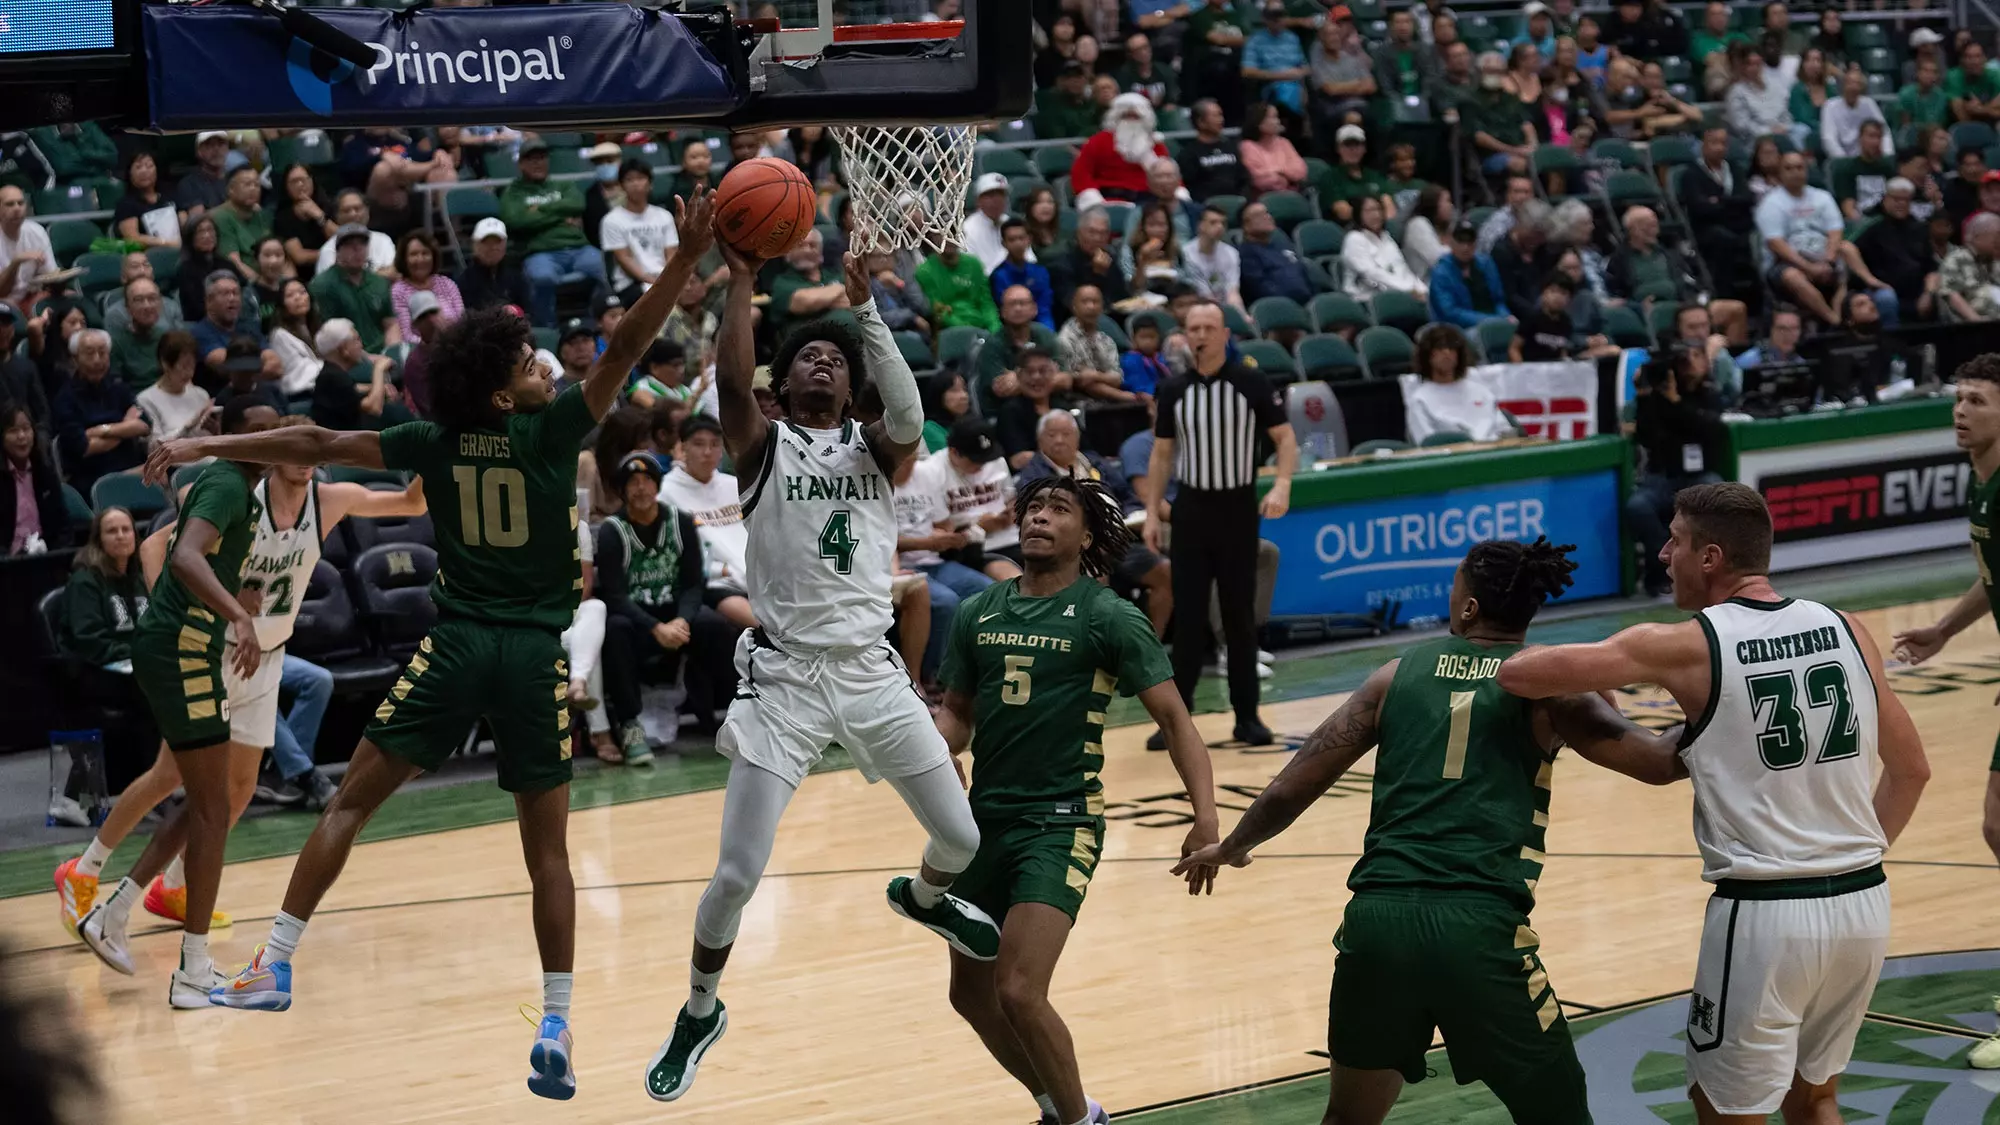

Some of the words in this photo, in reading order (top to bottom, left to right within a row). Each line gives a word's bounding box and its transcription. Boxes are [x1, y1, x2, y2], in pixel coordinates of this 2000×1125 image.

[459, 433, 511, 459] GRAVES
[452, 465, 530, 548] 10
[1315, 498, 1544, 564] OUTRIGGER
[1765, 475, 1879, 531] ESPN
[818, 510, 860, 575] 4
[977, 632, 1072, 652] CHARLOTTE
[1434, 654, 1501, 680] ROSADO
[1736, 626, 1841, 665] CHRISTENSEN
[1001, 655, 1035, 706] 5
[1442, 690, 1477, 779] 1
[1745, 660, 1861, 771] 32
